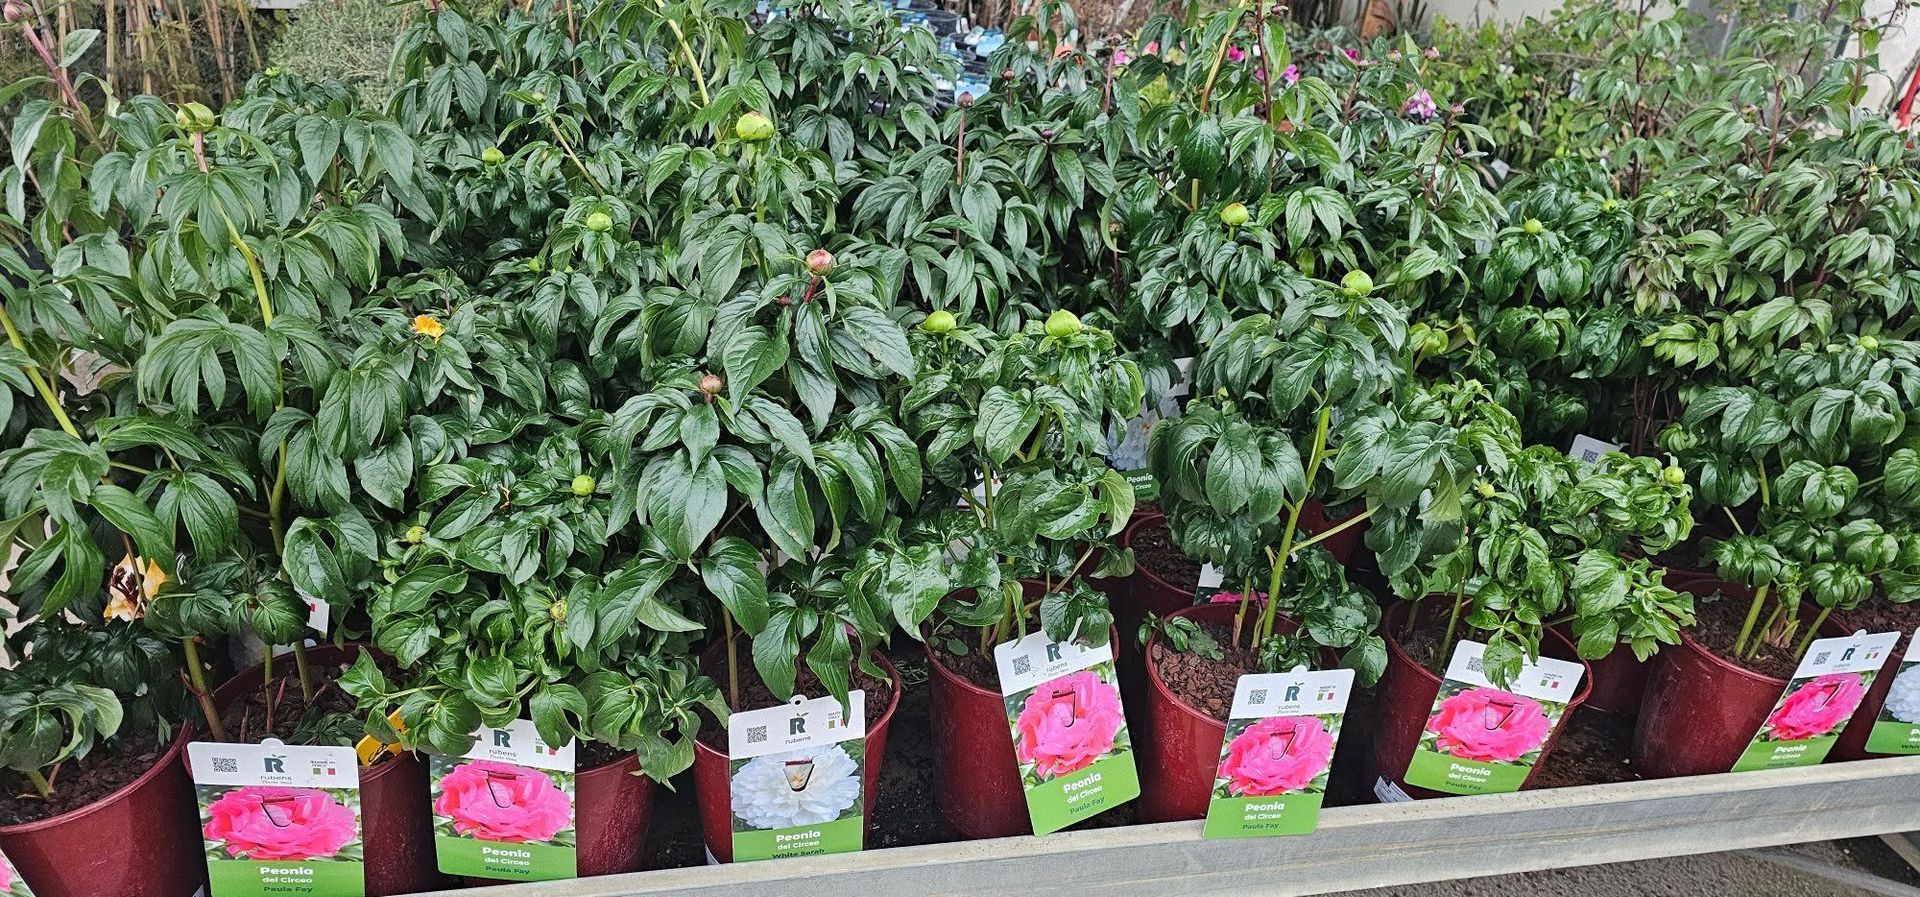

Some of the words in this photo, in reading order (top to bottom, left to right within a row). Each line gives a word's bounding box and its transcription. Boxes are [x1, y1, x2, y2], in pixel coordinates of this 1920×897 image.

[1127, 473, 1153, 483] Peonia
[785, 736, 811, 744] rubens
[489, 749, 517, 757] rubens
[1774, 744, 1807, 753] Peonia
[1450, 763, 1491, 776] Peonia
[1064, 773, 1101, 793] Peonia
[1462, 775, 1486, 783] Circeo
[1067, 794, 1078, 803] del
[1080, 786, 1102, 798] Circeo
[1070, 803, 1090, 814] Paula
[1092, 797, 1104, 805] Fay
[1245, 801, 1285, 812] Peonia
[776, 830, 821, 842] Peonia
[792, 840, 819, 848] Circeo
[482, 847, 531, 858] Peonia
[800, 849, 825, 857] Sarah
[259, 867, 314, 875] Peonia
